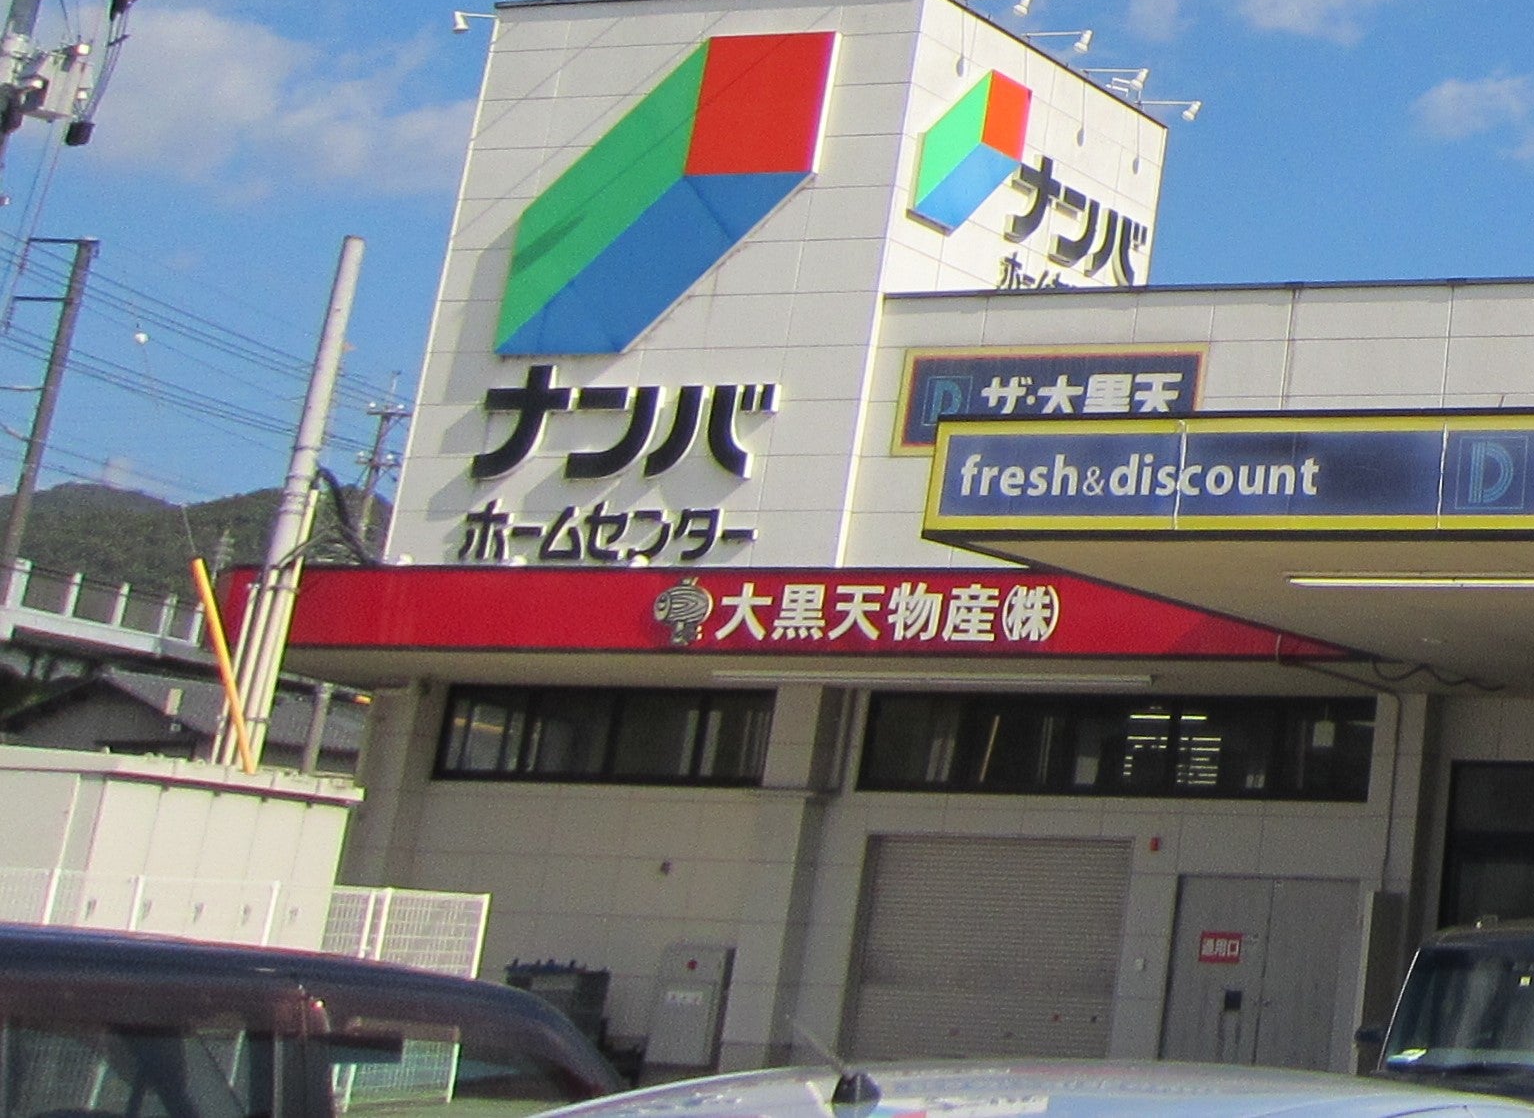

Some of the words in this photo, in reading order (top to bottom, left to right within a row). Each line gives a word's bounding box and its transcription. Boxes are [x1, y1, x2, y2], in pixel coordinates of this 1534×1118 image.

[1003, 154, 1148, 286] ナンバ
[470, 364, 782, 480] ナンバ
[960, 453, 1320, 496] fresh&discount
[458, 498, 759, 561] ホームセンター
